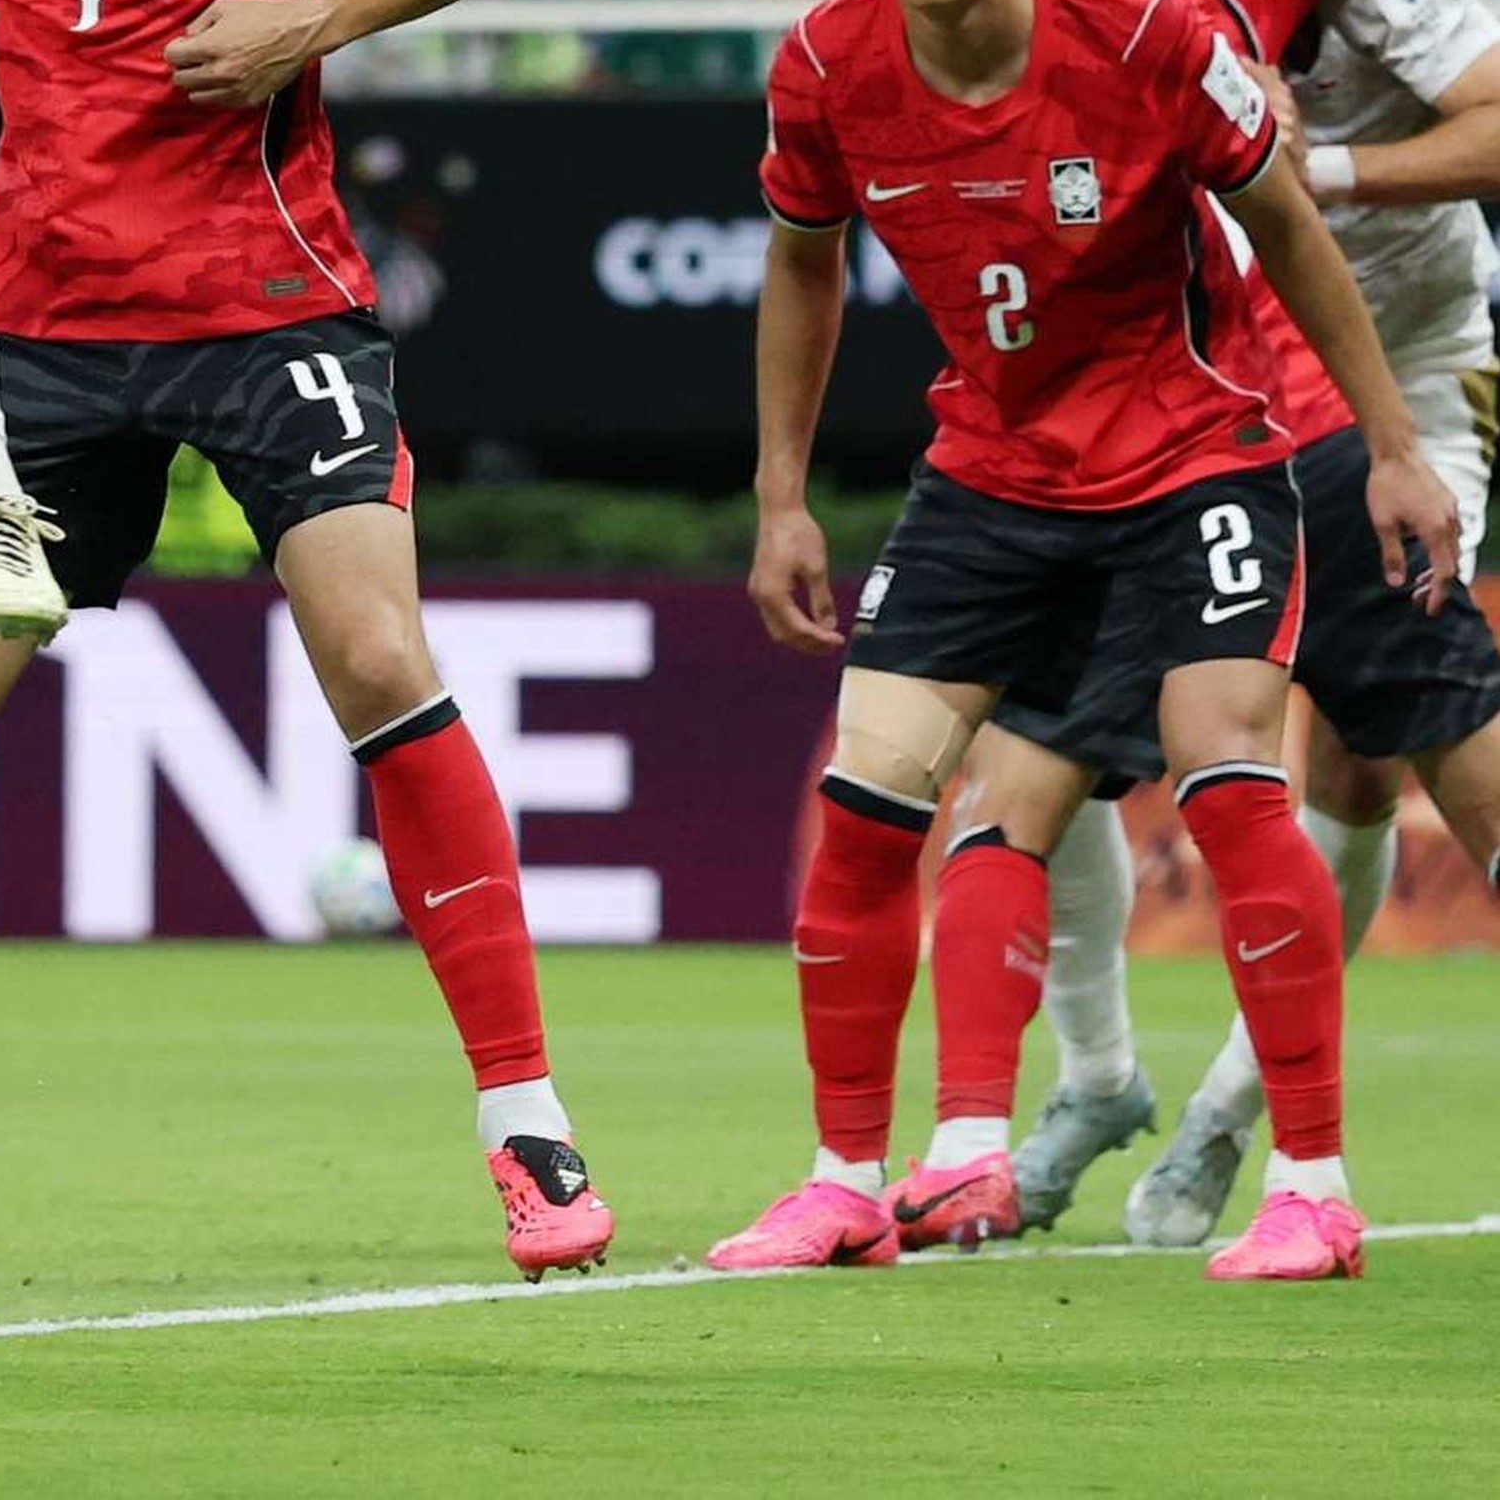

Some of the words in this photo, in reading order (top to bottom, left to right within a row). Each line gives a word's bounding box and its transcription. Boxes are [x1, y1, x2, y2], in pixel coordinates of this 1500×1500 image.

[980, 263, 1034, 352] 2
[284, 353, 365, 441] 4
[1199, 503, 1262, 595] 2
